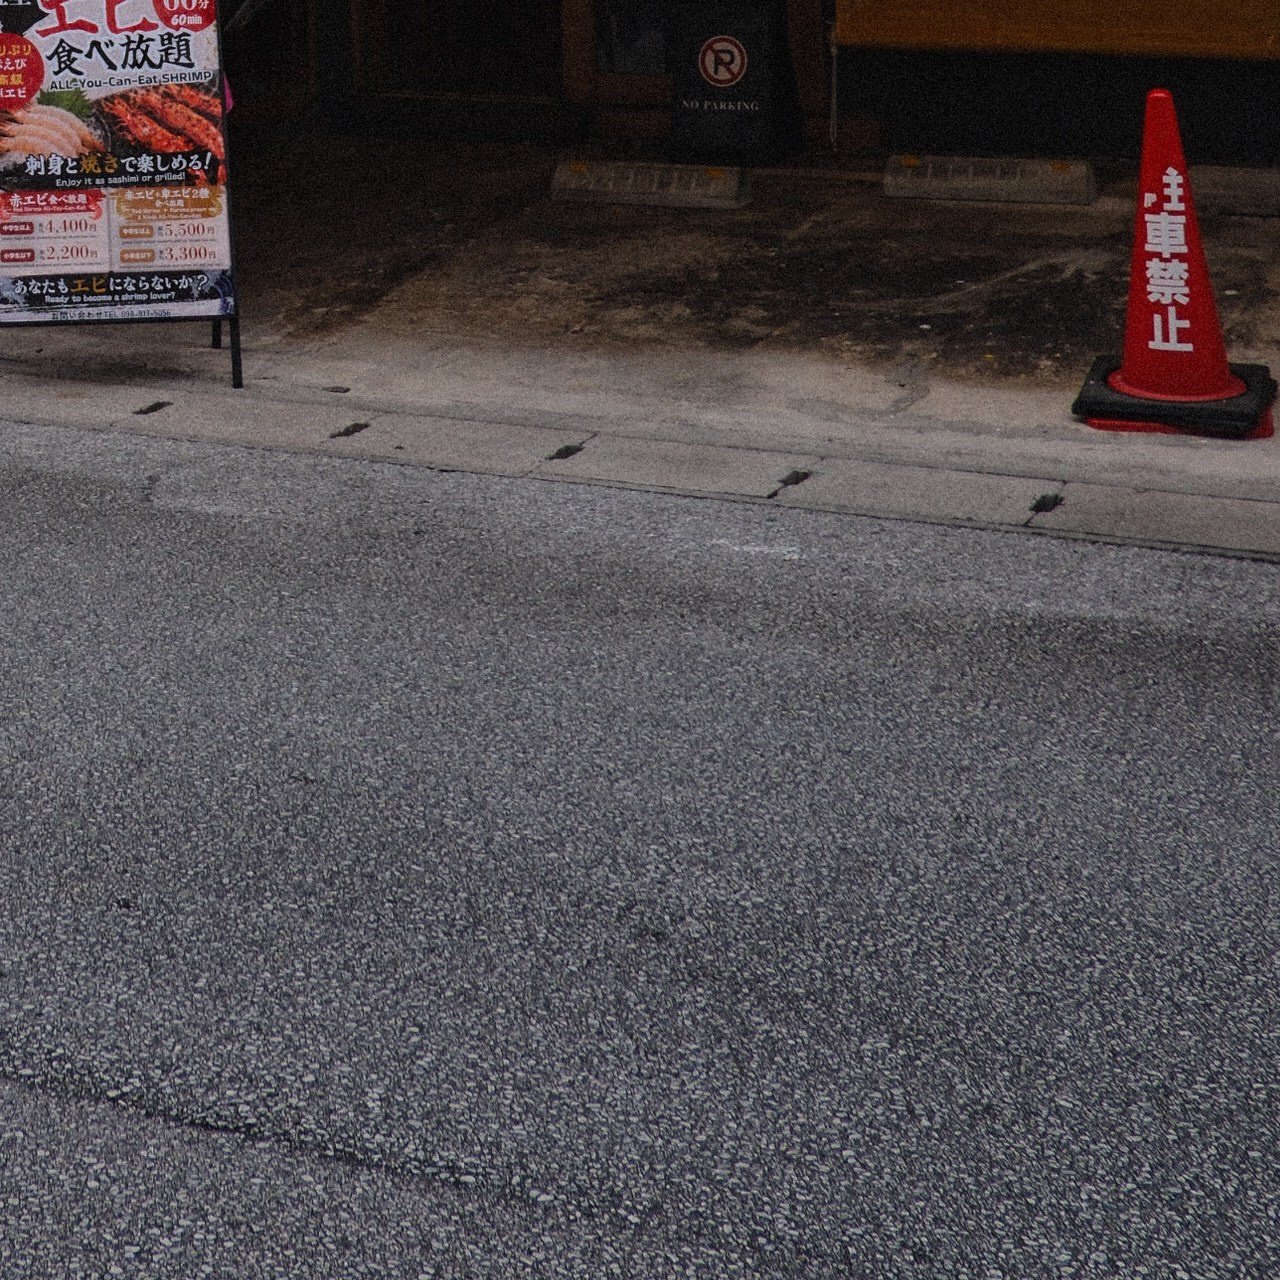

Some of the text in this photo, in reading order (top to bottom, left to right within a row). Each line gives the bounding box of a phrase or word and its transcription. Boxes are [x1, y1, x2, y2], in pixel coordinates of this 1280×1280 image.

[46, 31, 195, 76] 食べ放題
[50, 71, 212, 91] ALL-You-Can-Eat SHRIMP
[682, 100, 760, 111] NO PARKING
[56, 178, 82, 187] Enjoy
[84, 177, 92, 185] it
[108, 175, 139, 184] sashimi
[155, 172, 186, 183] grilled!
[45, 294, 69, 303] Ready
[83, 293, 113, 302] become
[121, 292, 148, 301] shrimp
